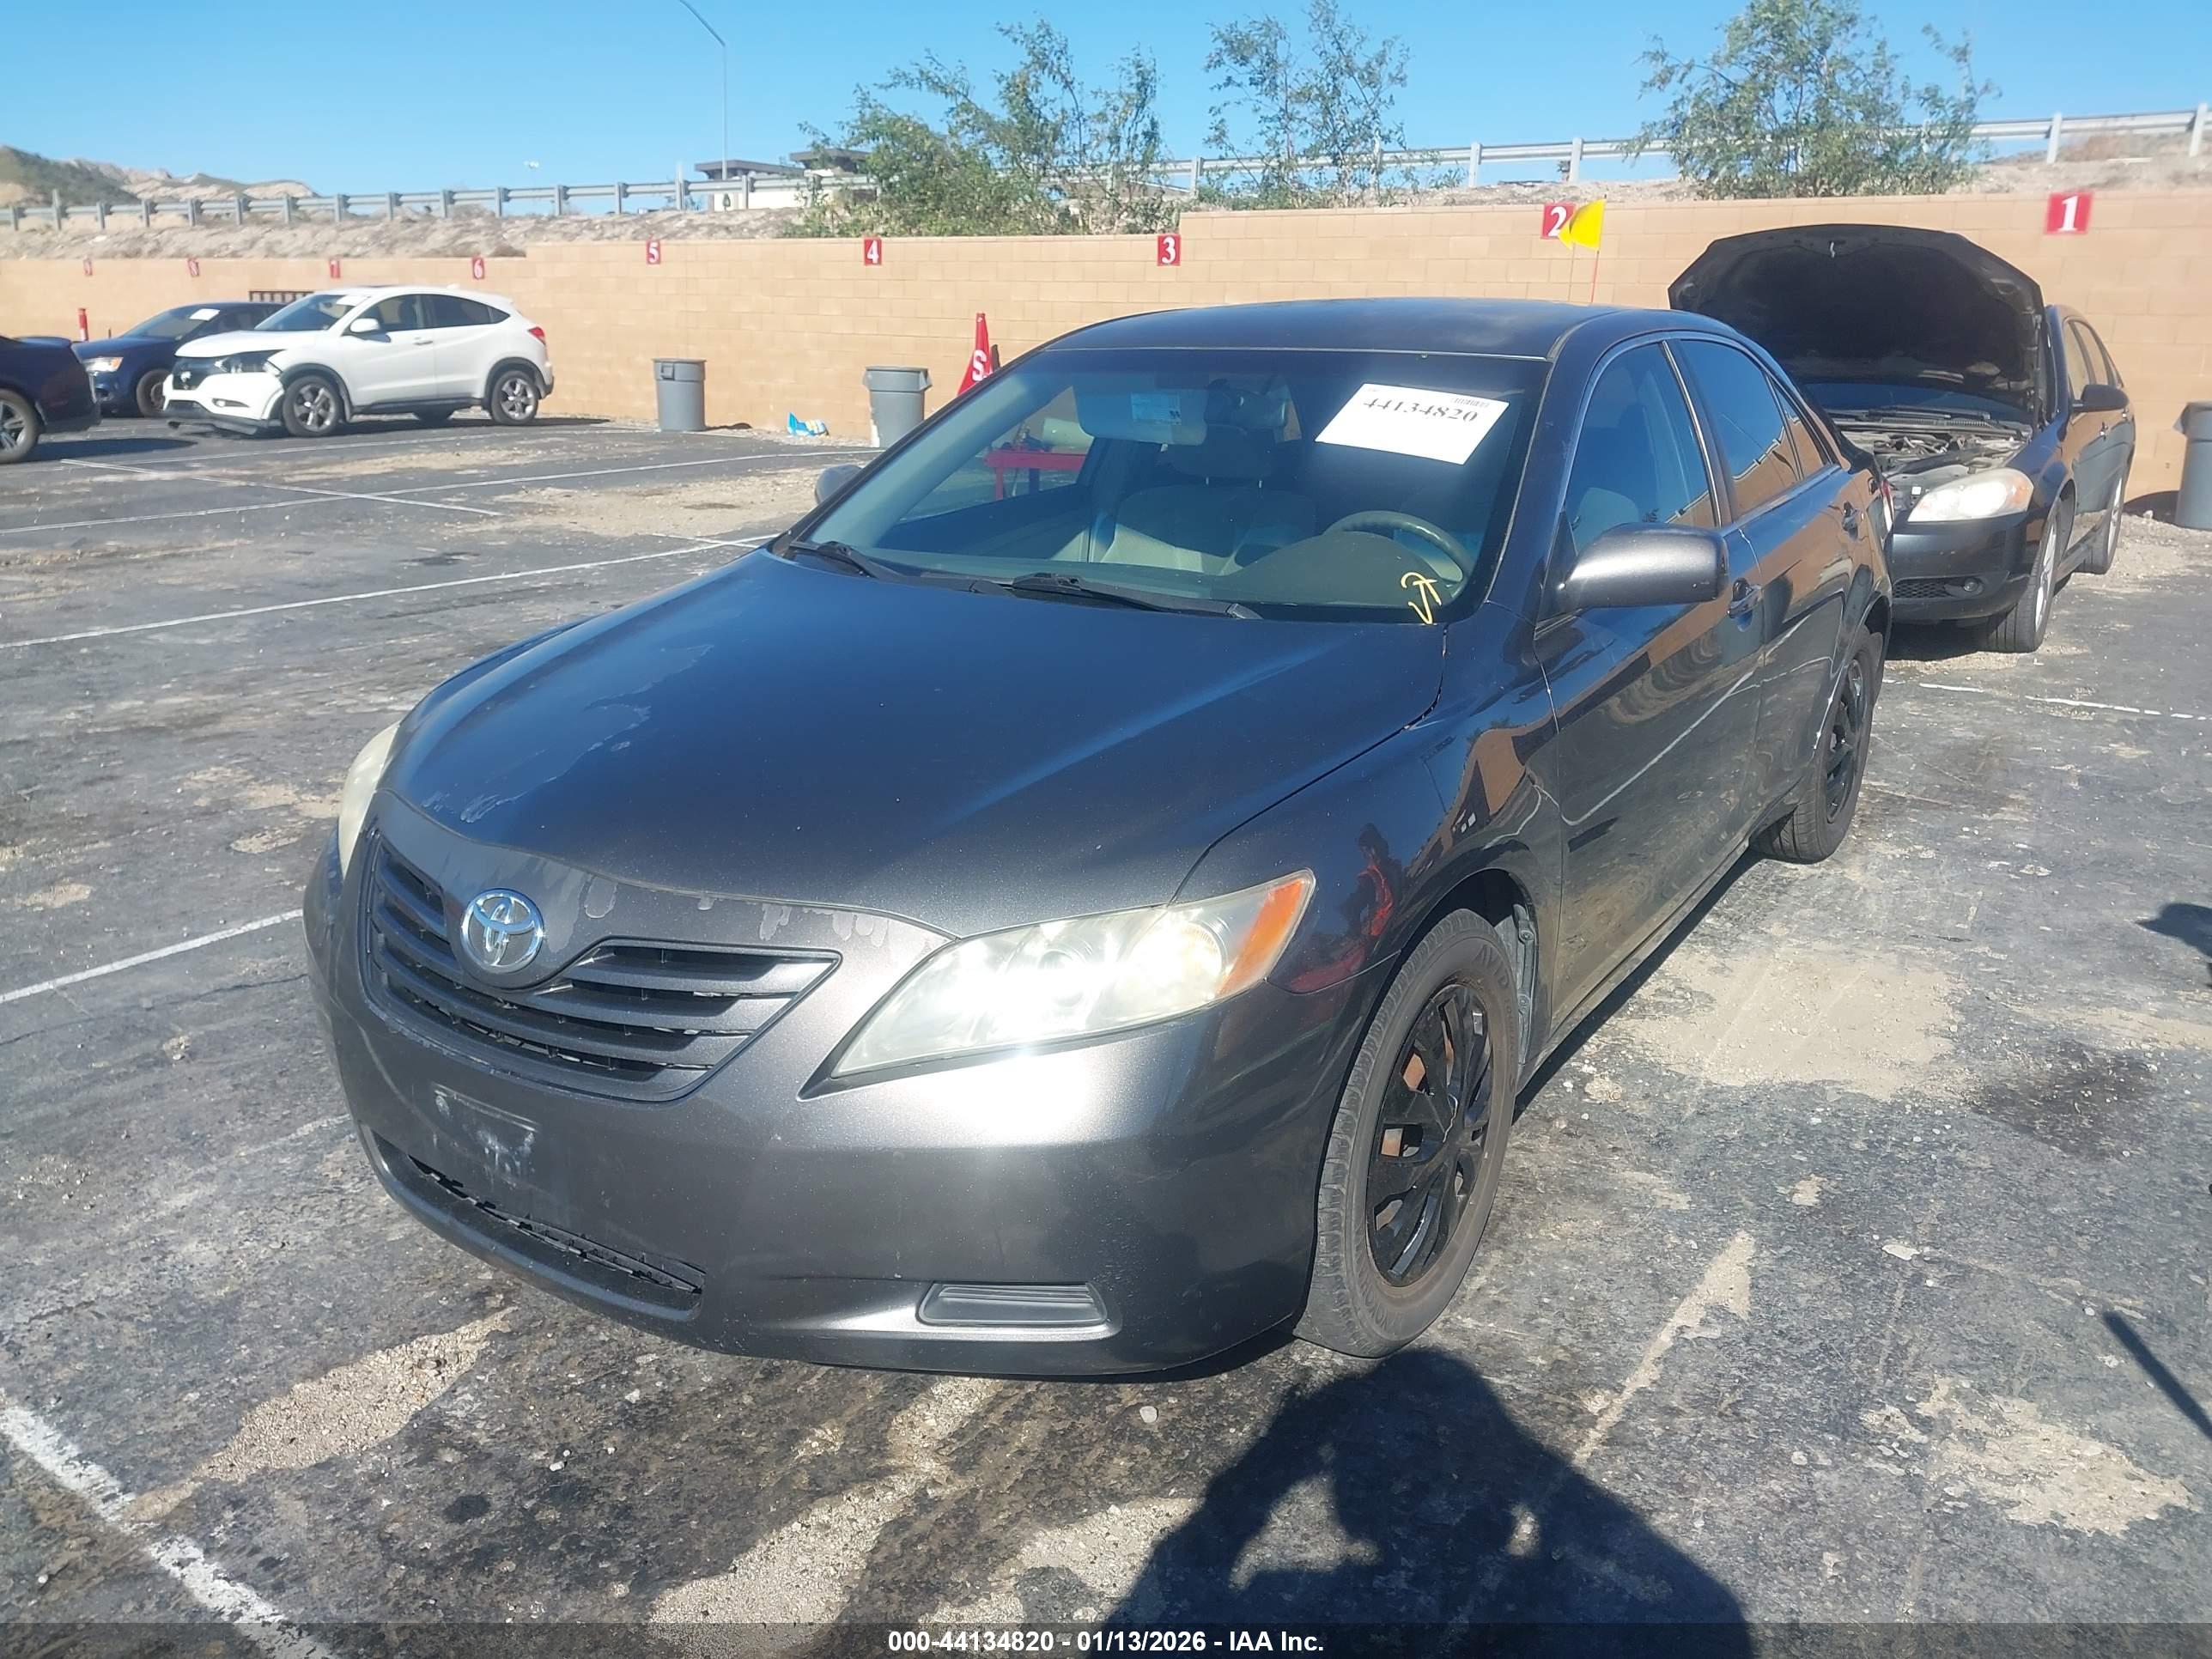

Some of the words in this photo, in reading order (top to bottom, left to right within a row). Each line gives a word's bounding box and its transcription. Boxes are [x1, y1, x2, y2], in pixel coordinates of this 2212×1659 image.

[1547, 206, 1566, 237] 2
[2058, 195, 2078, 232] 1
[648, 241, 659, 264] 5
[866, 240, 879, 264] 4
[1161, 236, 1176, 264] 3
[1364, 398, 1478, 422] 44134820
